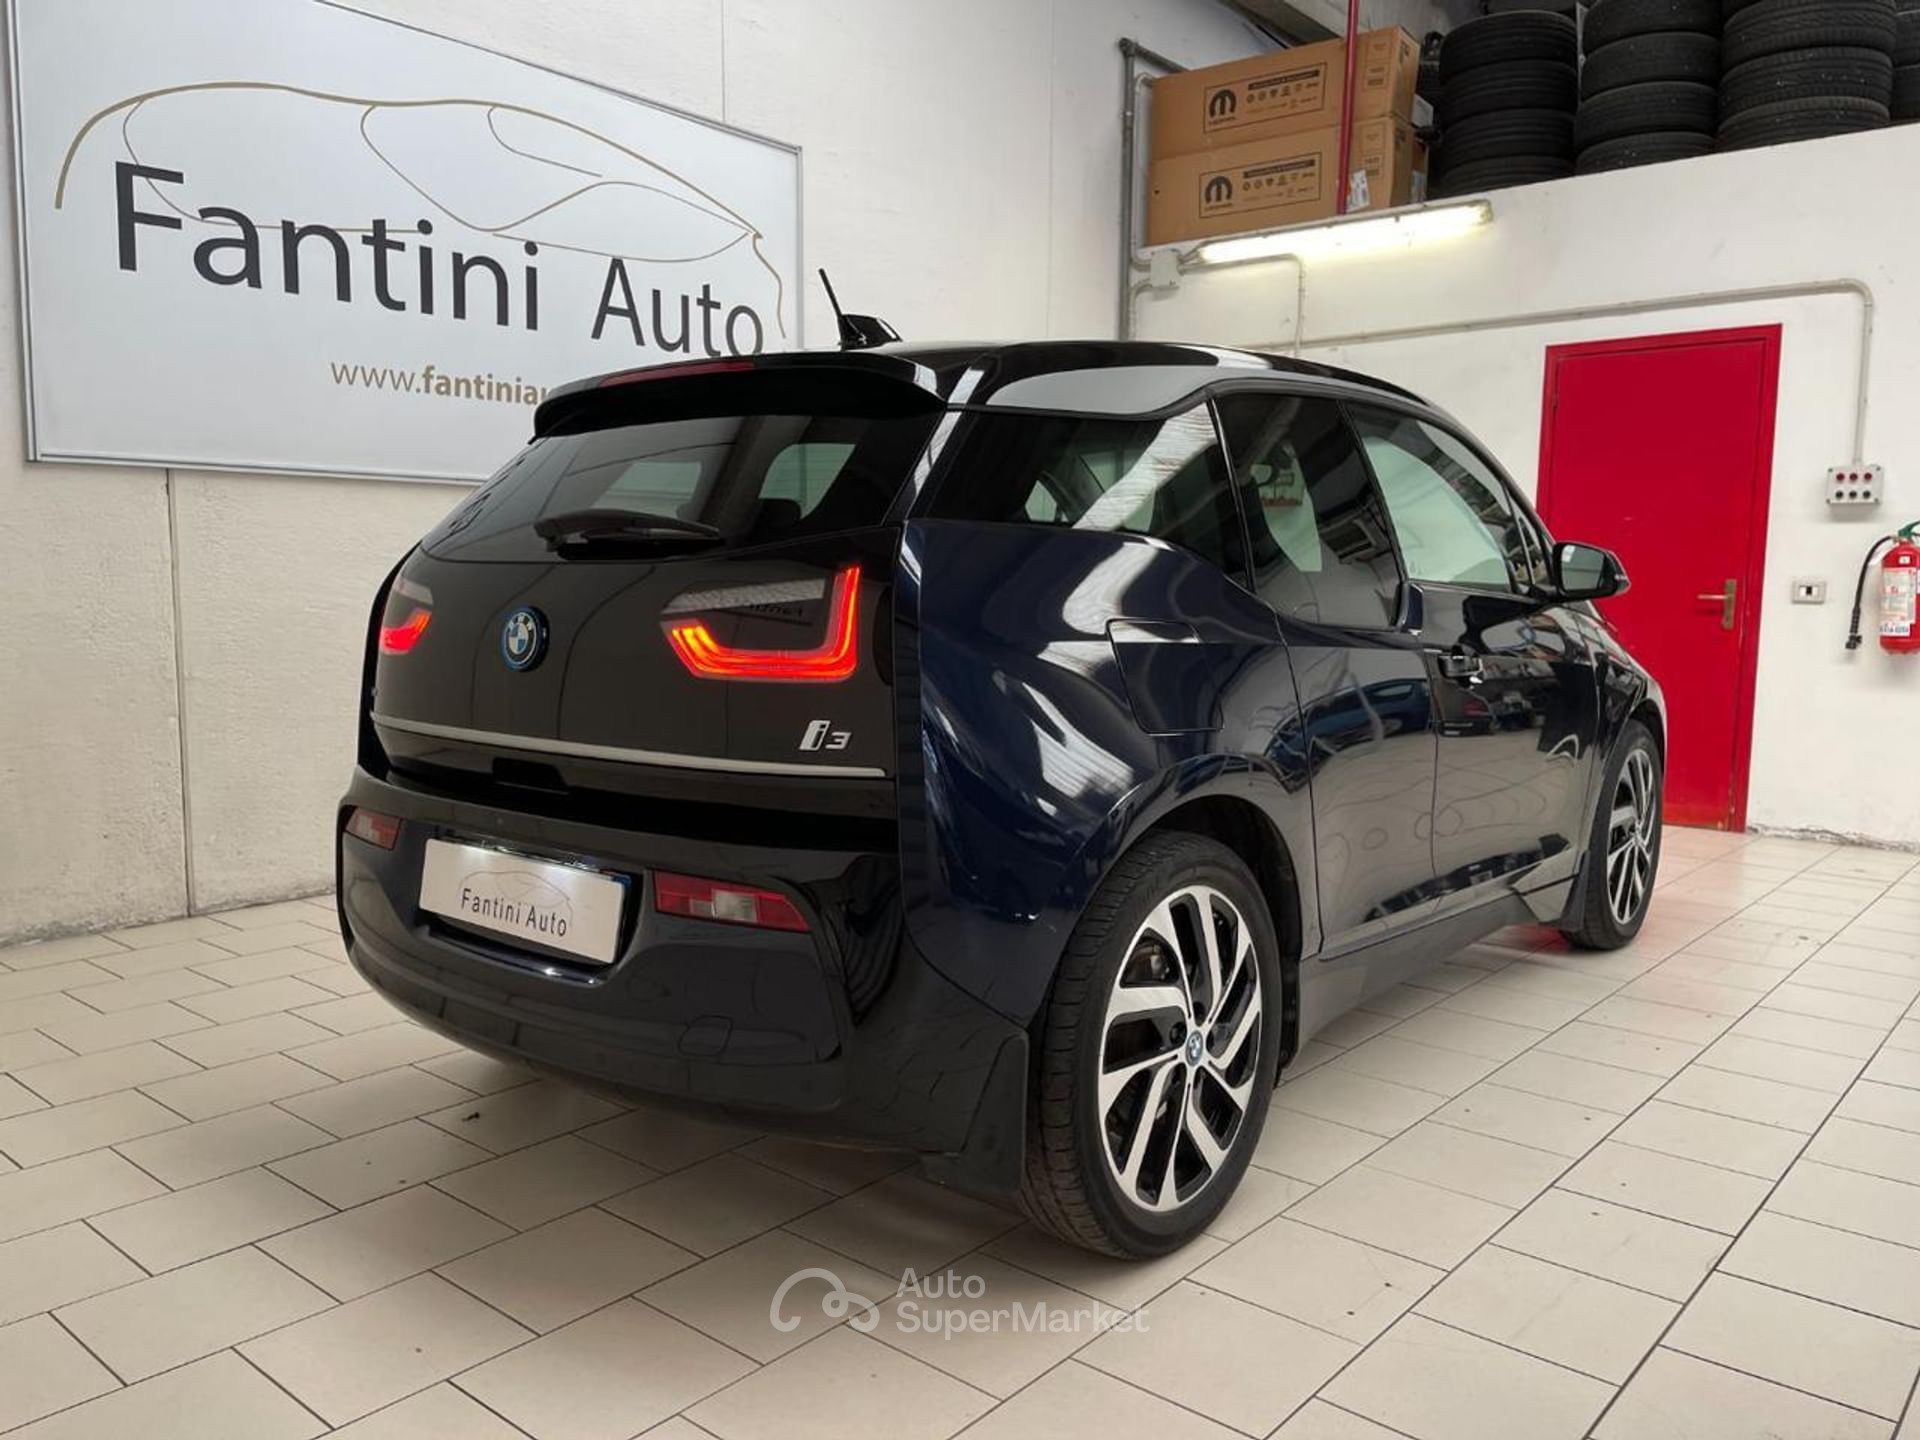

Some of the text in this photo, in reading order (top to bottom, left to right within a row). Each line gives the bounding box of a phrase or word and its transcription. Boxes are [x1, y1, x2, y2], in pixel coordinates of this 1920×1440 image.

[114, 160, 764, 358] Fantini Auto
[798, 719, 852, 751] i3
[461, 887, 568, 937] Fantini Auto
